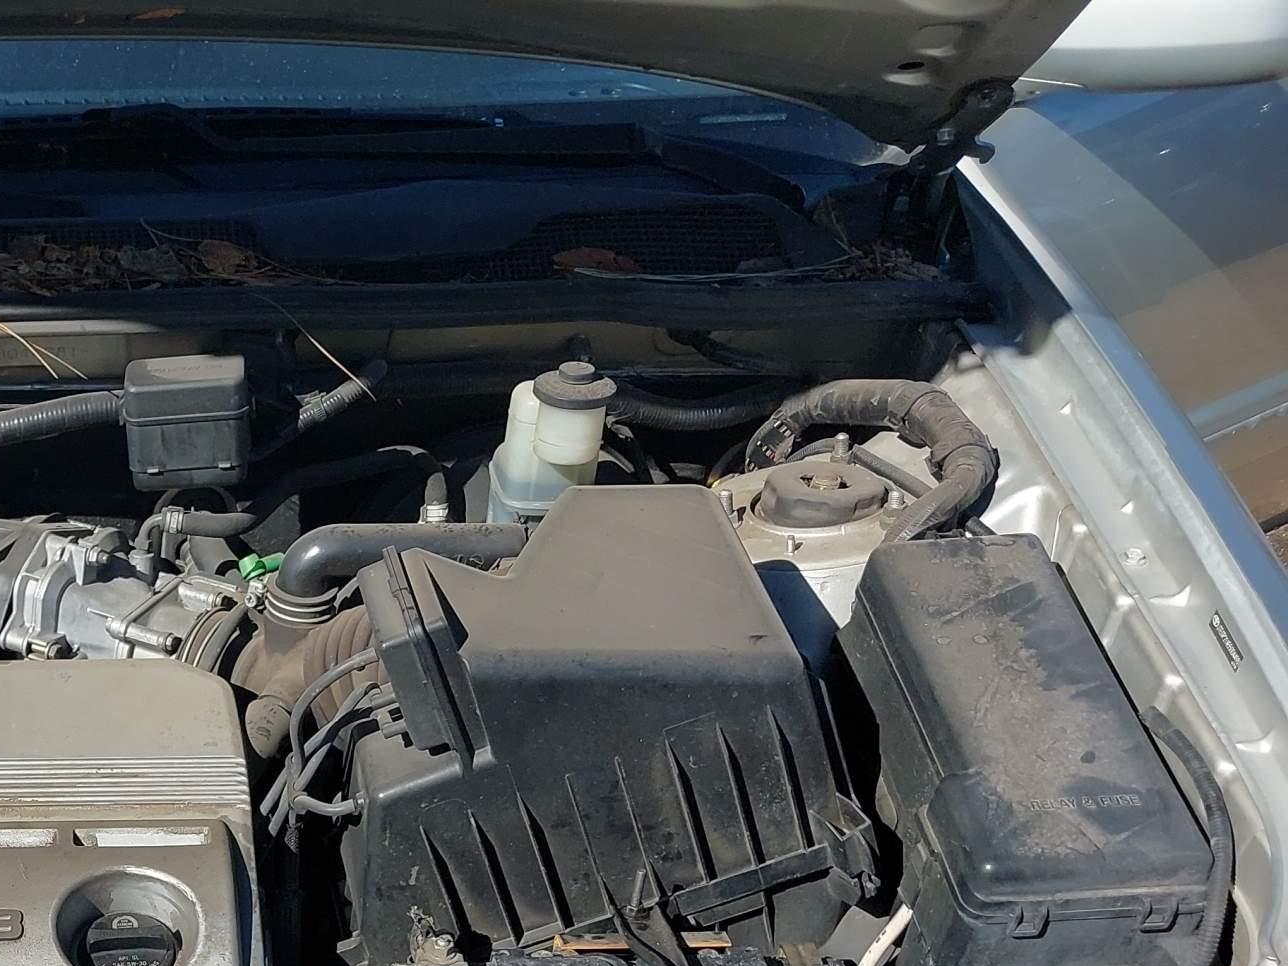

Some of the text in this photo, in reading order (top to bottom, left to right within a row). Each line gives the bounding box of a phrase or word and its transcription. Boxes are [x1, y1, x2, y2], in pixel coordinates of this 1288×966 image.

[1030, 794, 1142, 811] RELAY & FUSE
